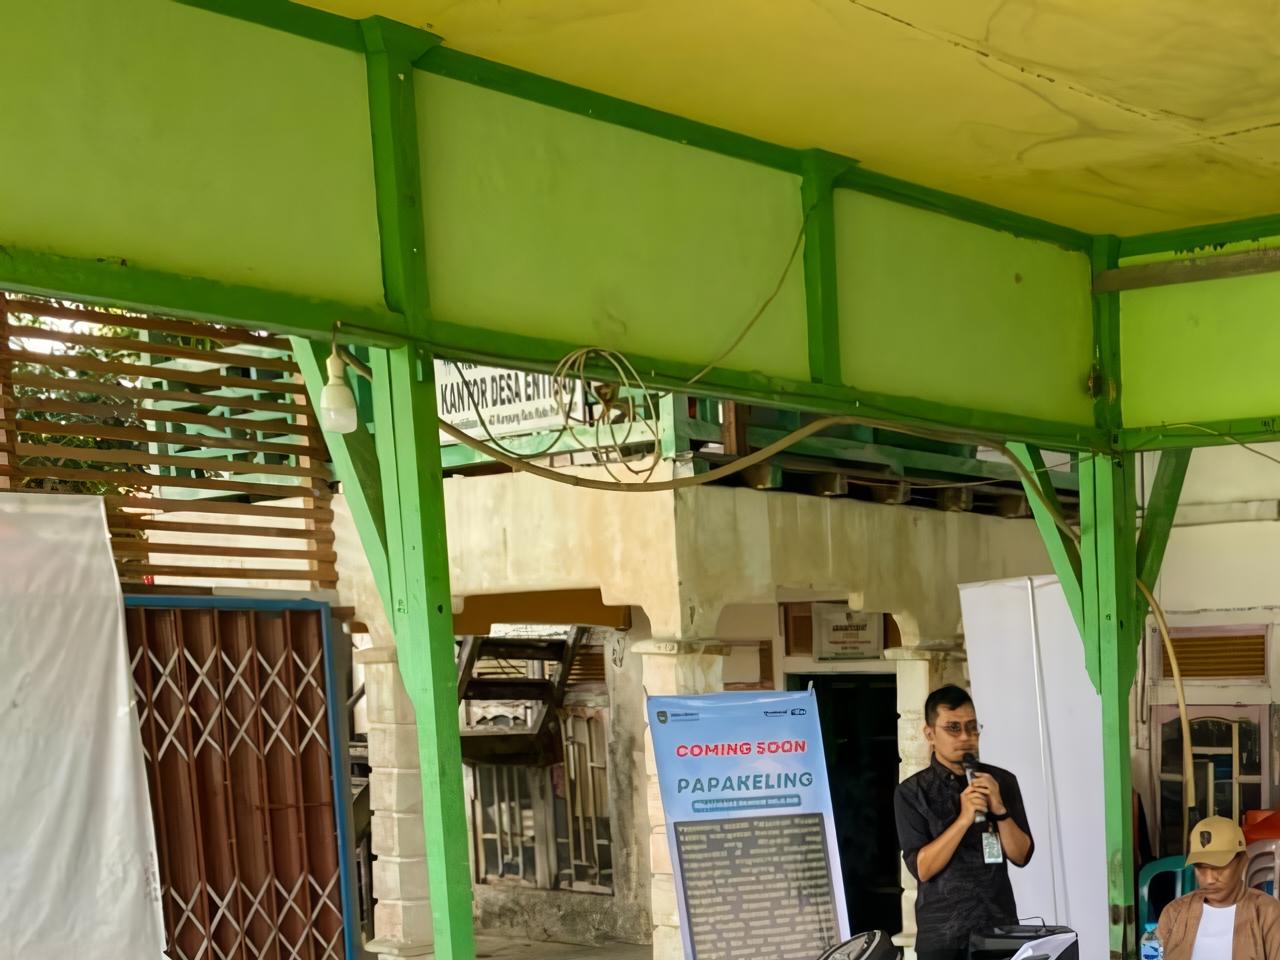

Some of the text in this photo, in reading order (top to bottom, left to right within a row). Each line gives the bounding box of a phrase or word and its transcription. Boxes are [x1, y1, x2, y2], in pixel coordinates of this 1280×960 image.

[440, 376, 489, 415] KANTOR
[491, 372, 521, 407] DESA
[676, 740, 806, 757] COMING SOON
[677, 772, 813, 793] PAPAKELING
